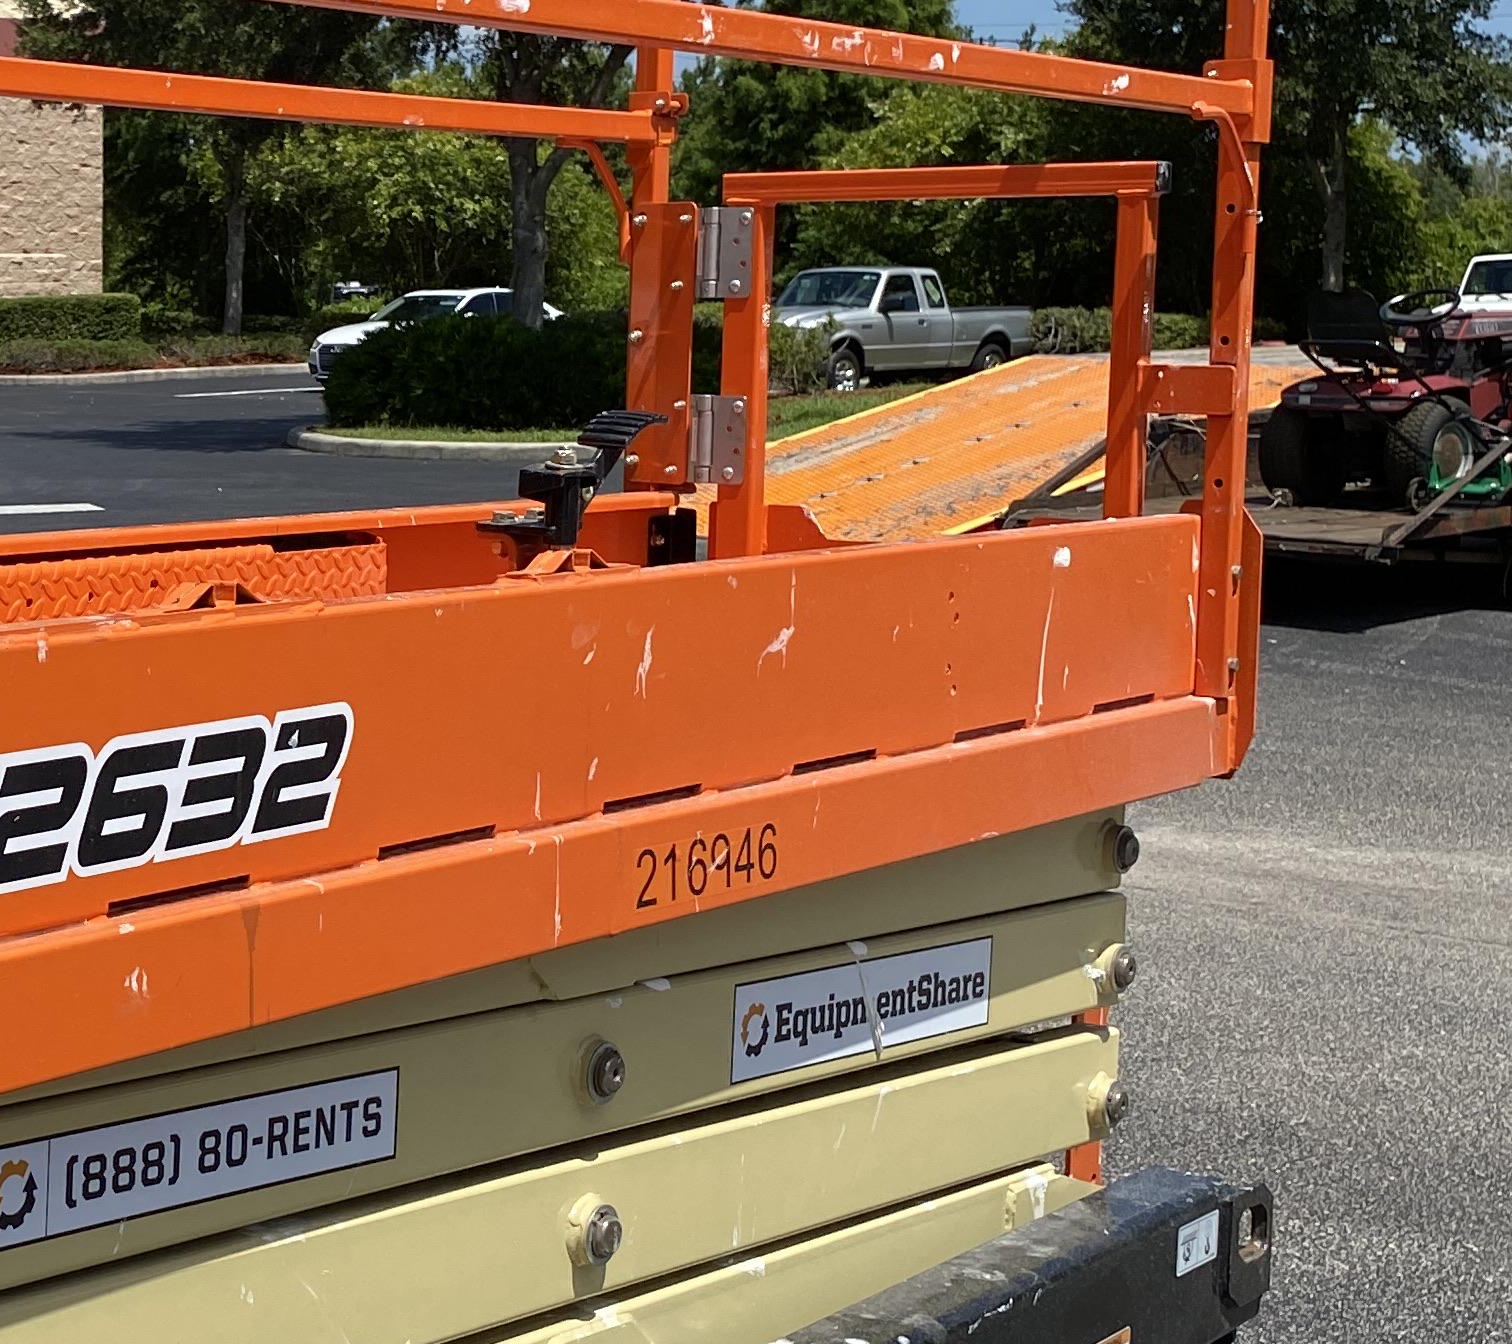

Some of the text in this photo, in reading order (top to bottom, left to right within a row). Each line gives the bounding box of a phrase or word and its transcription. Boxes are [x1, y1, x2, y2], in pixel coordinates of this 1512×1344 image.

[636, 824, 778, 909] 216946
[65, 1096, 383, 1209] (888) 80-RENTS
